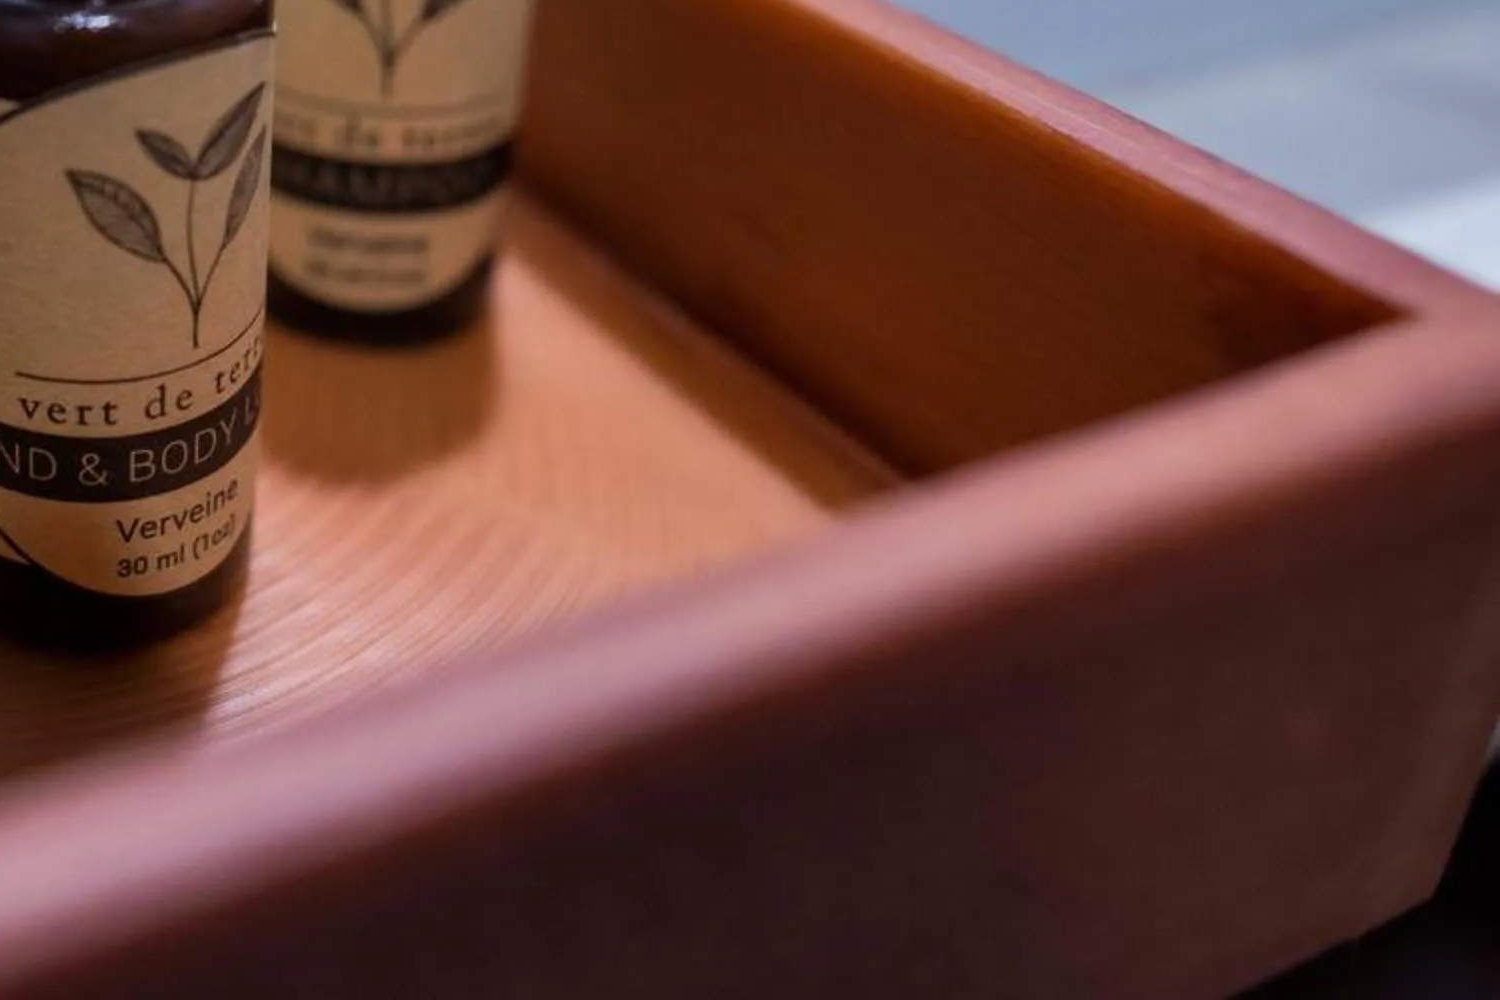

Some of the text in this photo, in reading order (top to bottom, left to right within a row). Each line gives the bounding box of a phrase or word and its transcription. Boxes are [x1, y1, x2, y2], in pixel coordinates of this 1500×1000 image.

[18, 396, 118, 427] vert
[144, 382, 194, 420] de
[78, 453, 108, 487] &
[129, 406, 238, 483] BODY
[116, 479, 238, 543] Verveine
[116, 556, 149, 578] 30
[156, 542, 186, 571] ml
